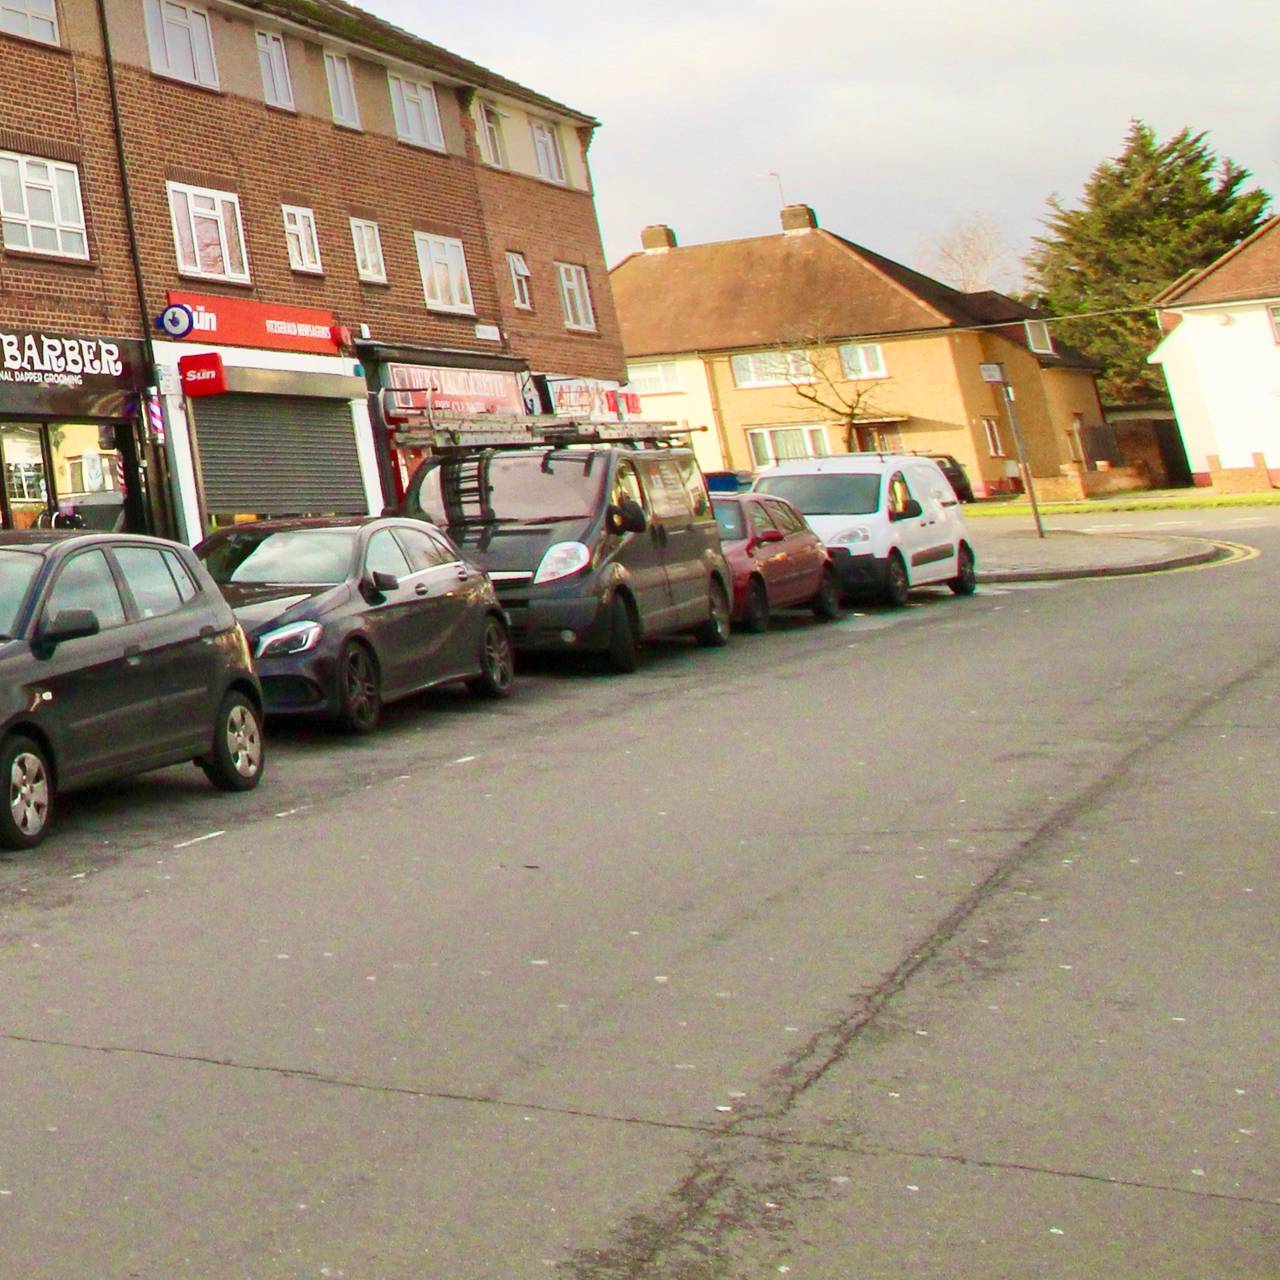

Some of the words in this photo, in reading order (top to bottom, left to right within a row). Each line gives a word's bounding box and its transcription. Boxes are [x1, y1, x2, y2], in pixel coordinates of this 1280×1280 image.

[183, 304, 217, 332] un
[0, 332, 123, 376] BARBER
[14, 371, 44, 384] DAPPER
[44, 373, 83, 385] GROOMING
